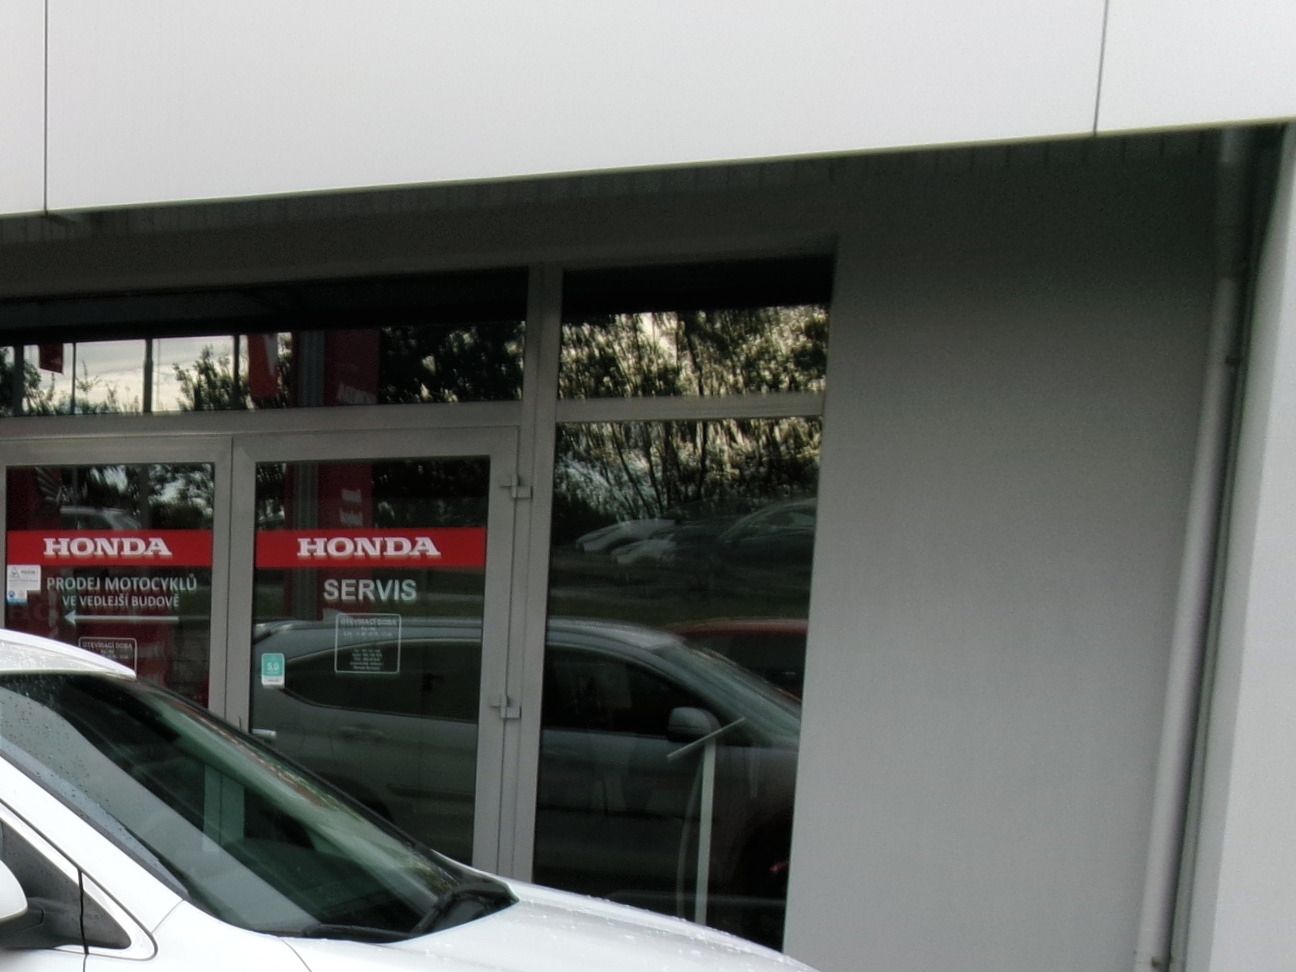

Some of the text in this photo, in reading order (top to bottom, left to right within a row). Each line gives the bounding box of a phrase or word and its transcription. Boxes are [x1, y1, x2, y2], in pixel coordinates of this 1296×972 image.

[43, 537, 172, 558] HONDA
[297, 536, 441, 559] HONDA
[46, 573, 198, 592] PRODEJ MOTOCYKLŮ
[323, 579, 418, 602] SERVIS
[62, 594, 180, 608] VE VEDLEJŠÍ BUDOVĚ
